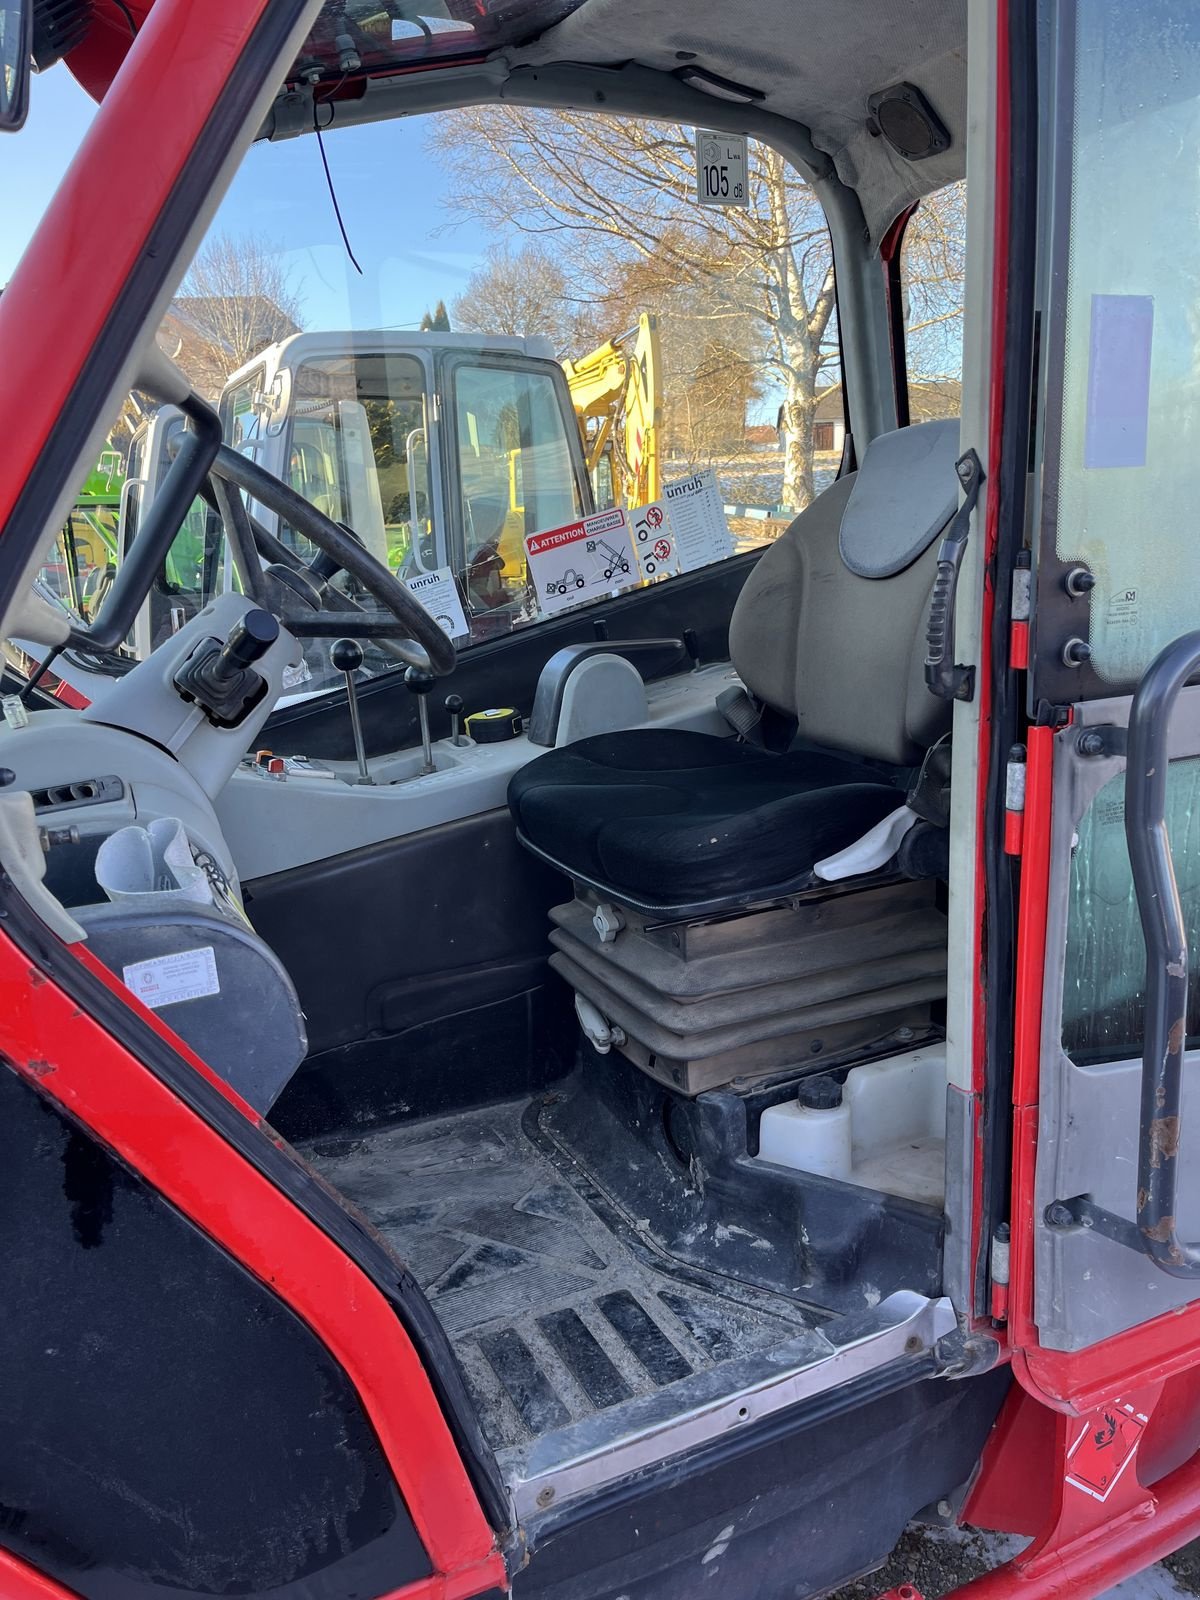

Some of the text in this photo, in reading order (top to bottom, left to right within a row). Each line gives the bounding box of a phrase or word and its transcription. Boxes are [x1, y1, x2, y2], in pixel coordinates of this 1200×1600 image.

[704, 165, 729, 197] 105
[733, 183, 744, 199] dB
[666, 477, 703, 498] unruh
[586, 519, 621, 534] CHARGE BASSE
[540, 527, 584, 548] ATTENTION
[410, 573, 440, 590] unruh
